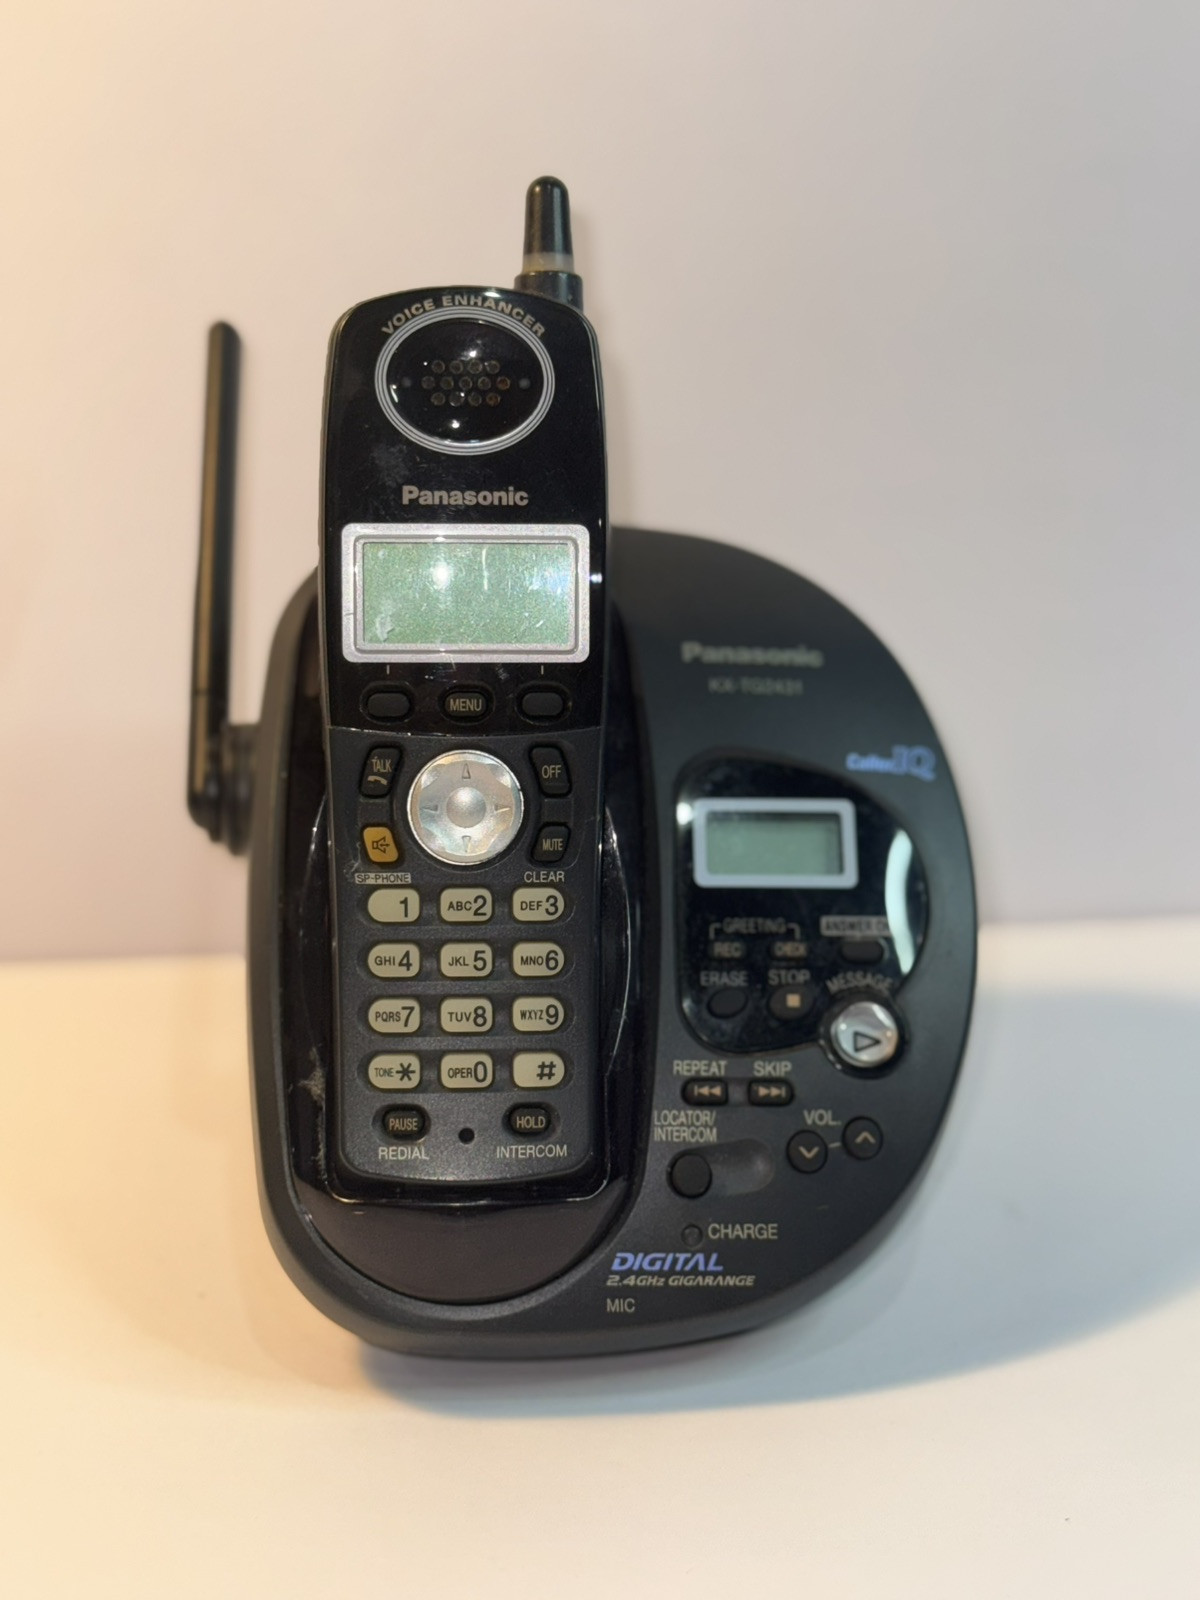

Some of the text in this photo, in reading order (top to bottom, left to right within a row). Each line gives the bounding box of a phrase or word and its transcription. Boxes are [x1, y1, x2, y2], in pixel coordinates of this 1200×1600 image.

[381, 294, 546, 337] VOICE ENHANCER
[402, 485, 529, 506] Panasonic
[680, 641, 824, 669] Panasonic
[449, 698, 482, 712] MENU
[371, 757, 392, 773] TALK
[541, 765, 562, 779] OFF
[542, 838, 564, 851] MUTE
[356, 873, 411, 884] SP-PHONE
[523, 871, 565, 883] CLEAR
[399, 896, 409, 918] 1
[722, 916, 787, 935] GREETING
[713, 941, 742, 958] REC
[700, 970, 749, 987] ERASE
[768, 968, 811, 985] STOP
[825, 970, 893, 996] MESSAGE
[374, 1067, 394, 1077] TONE
[536, 1060, 557, 1081] #
[673, 1060, 728, 1076] REPEAT
[753, 1060, 793, 1078] SKIP
[388, 1117, 418, 1130] PAUSE
[516, 1116, 546, 1129] HOLD
[653, 1109, 716, 1126] LOCATOR/
[803, 1108, 842, 1126] VOL.
[653, 1126, 717, 1143] INTERCOM
[378, 1146, 430, 1160] REDIAL
[496, 1144, 568, 1159] INTERCOM
[707, 1223, 778, 1240] CHARGE
[611, 1252, 724, 1271] DIGITAL
[606, 1274, 756, 1286] 2.4GHz GIGARANGE
[606, 1298, 636, 1313] MIC
